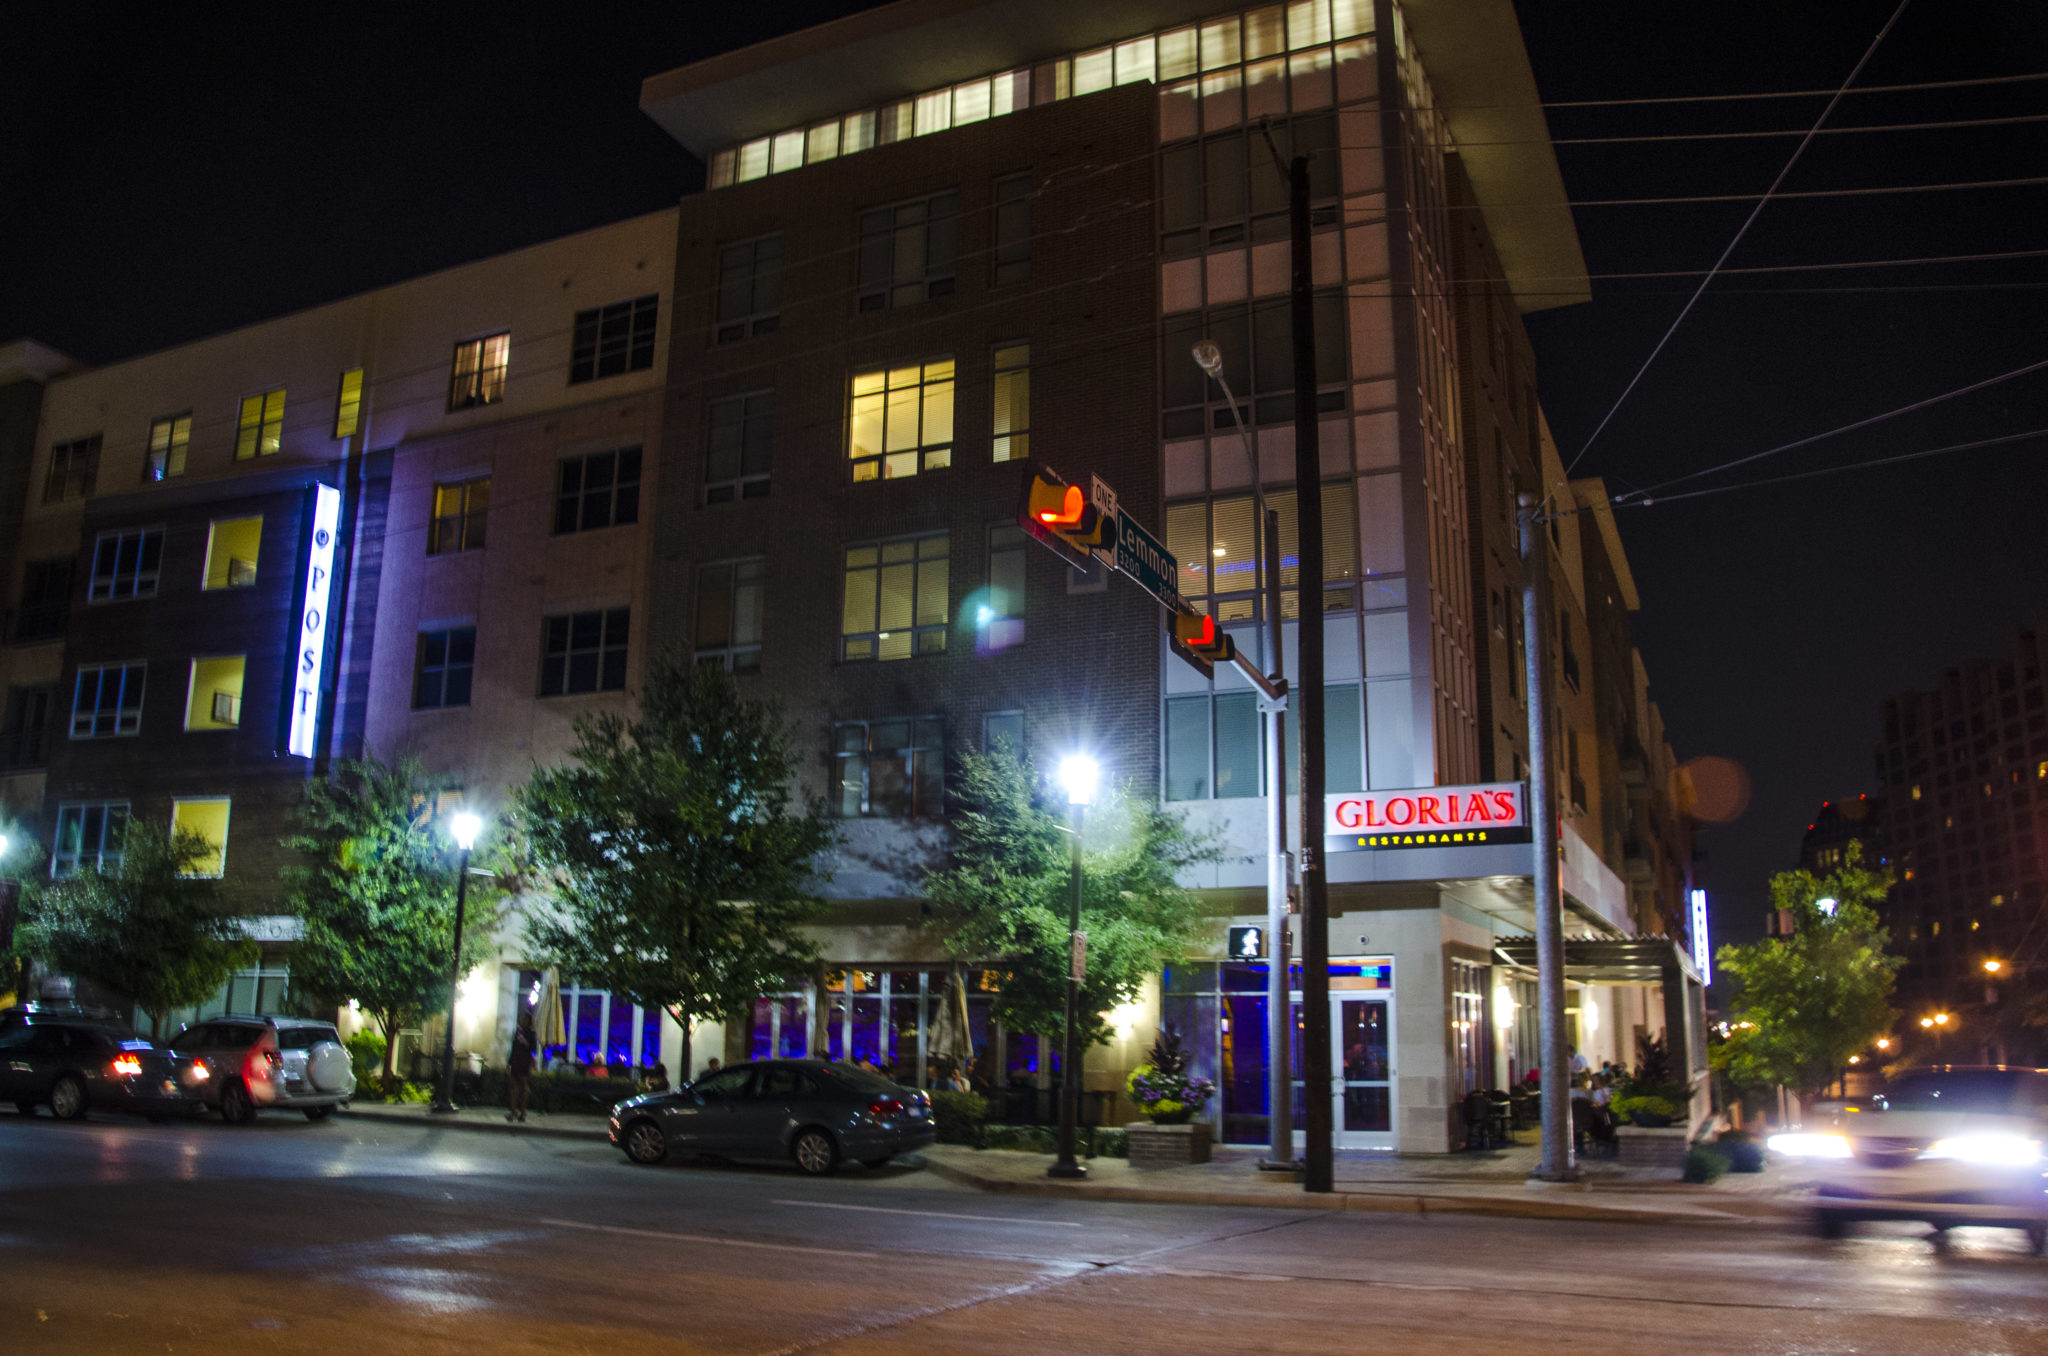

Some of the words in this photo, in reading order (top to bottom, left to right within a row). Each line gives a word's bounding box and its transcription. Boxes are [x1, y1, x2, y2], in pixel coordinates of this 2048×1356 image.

[1096, 484, 1112, 512] ONE
[1119, 514, 1177, 589] Lemmon
[1120, 550, 1140, 577] 3200
[1159, 582, 1177, 608] 3300
[298, 567, 325, 715] POST
[1335, 790, 1516, 828] GLORIA'S
[1357, 832, 1487, 846] RESTAURANTS
